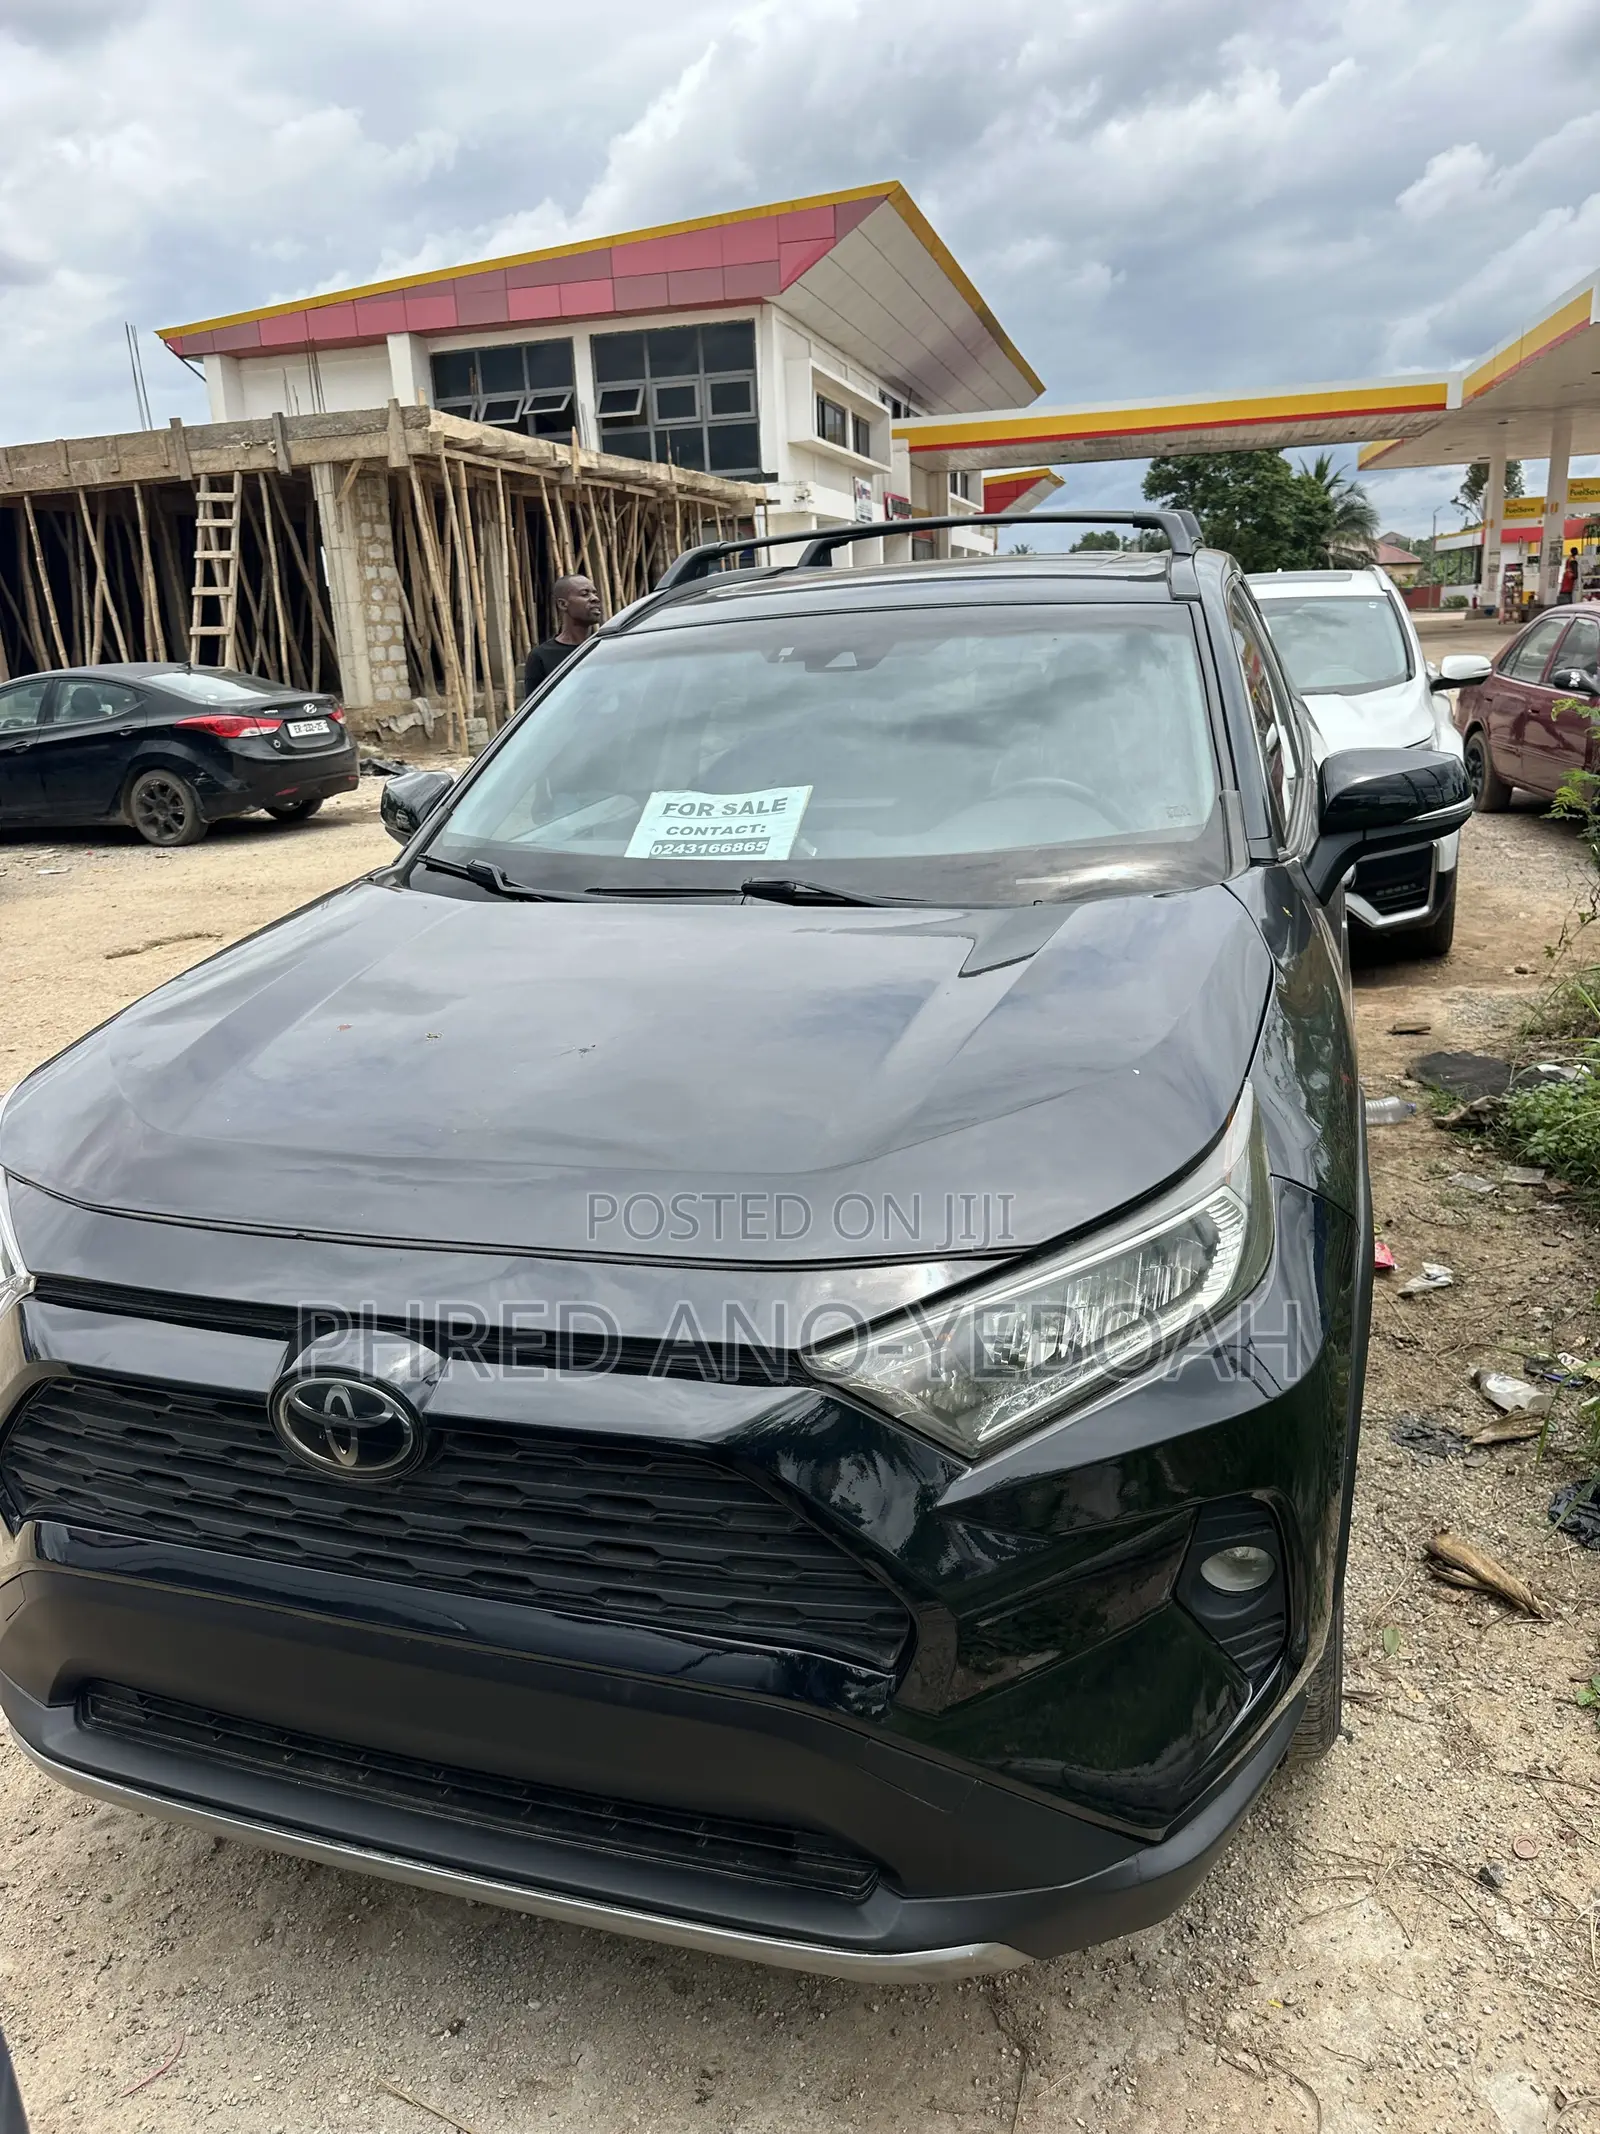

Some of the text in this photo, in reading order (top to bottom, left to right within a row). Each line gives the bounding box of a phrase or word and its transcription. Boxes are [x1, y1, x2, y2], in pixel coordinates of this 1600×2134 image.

[662, 797, 788, 817] FOR SALE
[666, 823, 766, 836] CONTACT:
[650, 840, 768, 855] 0243166865
